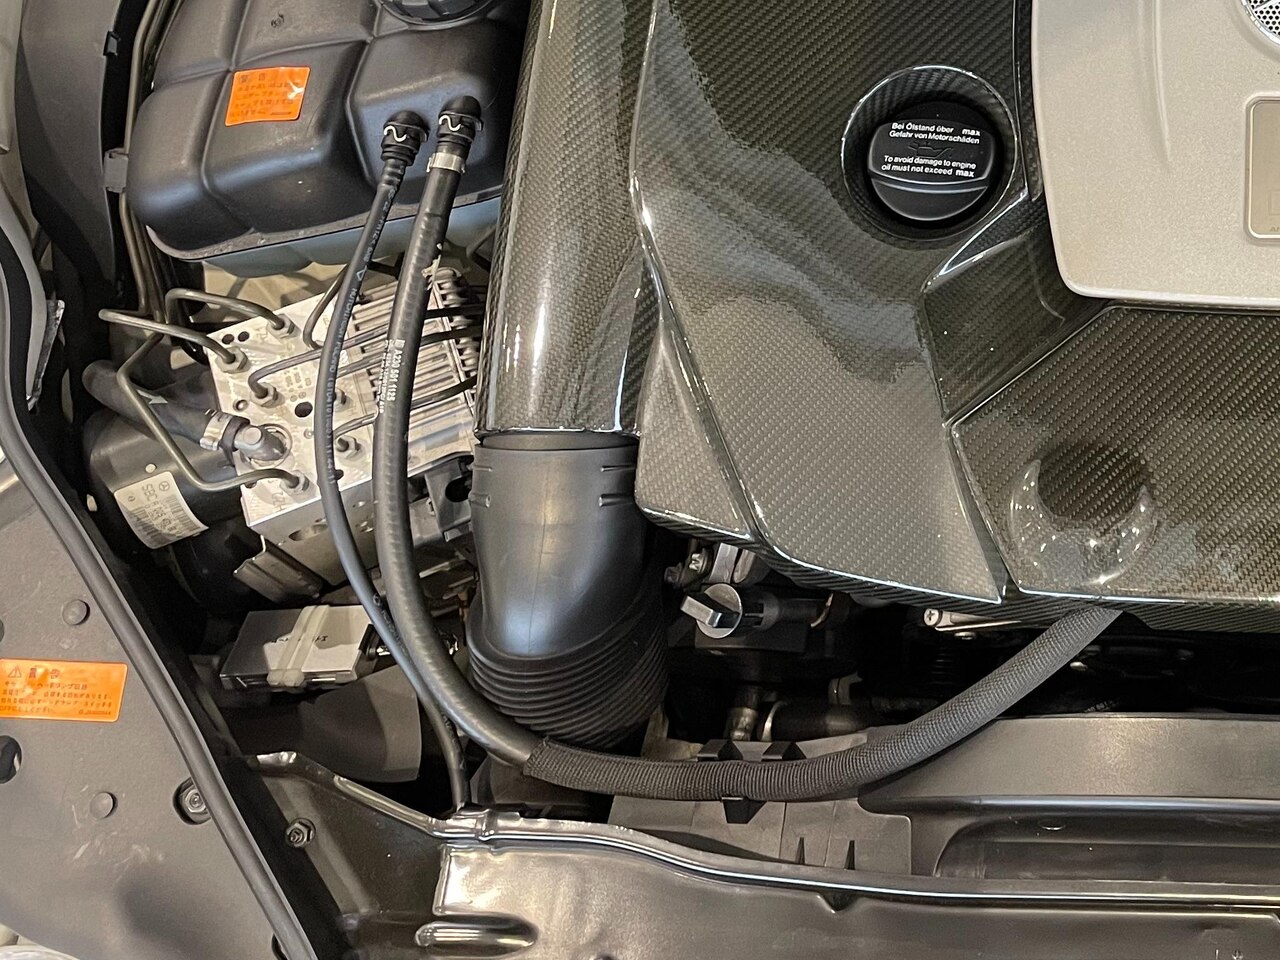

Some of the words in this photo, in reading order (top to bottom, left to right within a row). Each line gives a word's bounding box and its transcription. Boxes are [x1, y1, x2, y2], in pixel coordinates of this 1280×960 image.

[891, 122, 905, 130] Bei
[905, 122, 936, 132] Ölstand
[936, 124, 954, 134] über
[962, 128, 981, 137] max
[889, 130, 914, 139] Gefahr
[928, 133, 980, 145] Motorschäden
[884, 155, 893, 163] To
[893, 156, 914, 164] avoid
[914, 157, 943, 167] damage
[951, 160, 977, 171] engine
[891, 164, 910, 172] must
[924, 167, 953, 176] exceed
[955, 169, 975, 178] max
[390, 349, 403, 368] A230
[388, 369, 399, 382] 501
